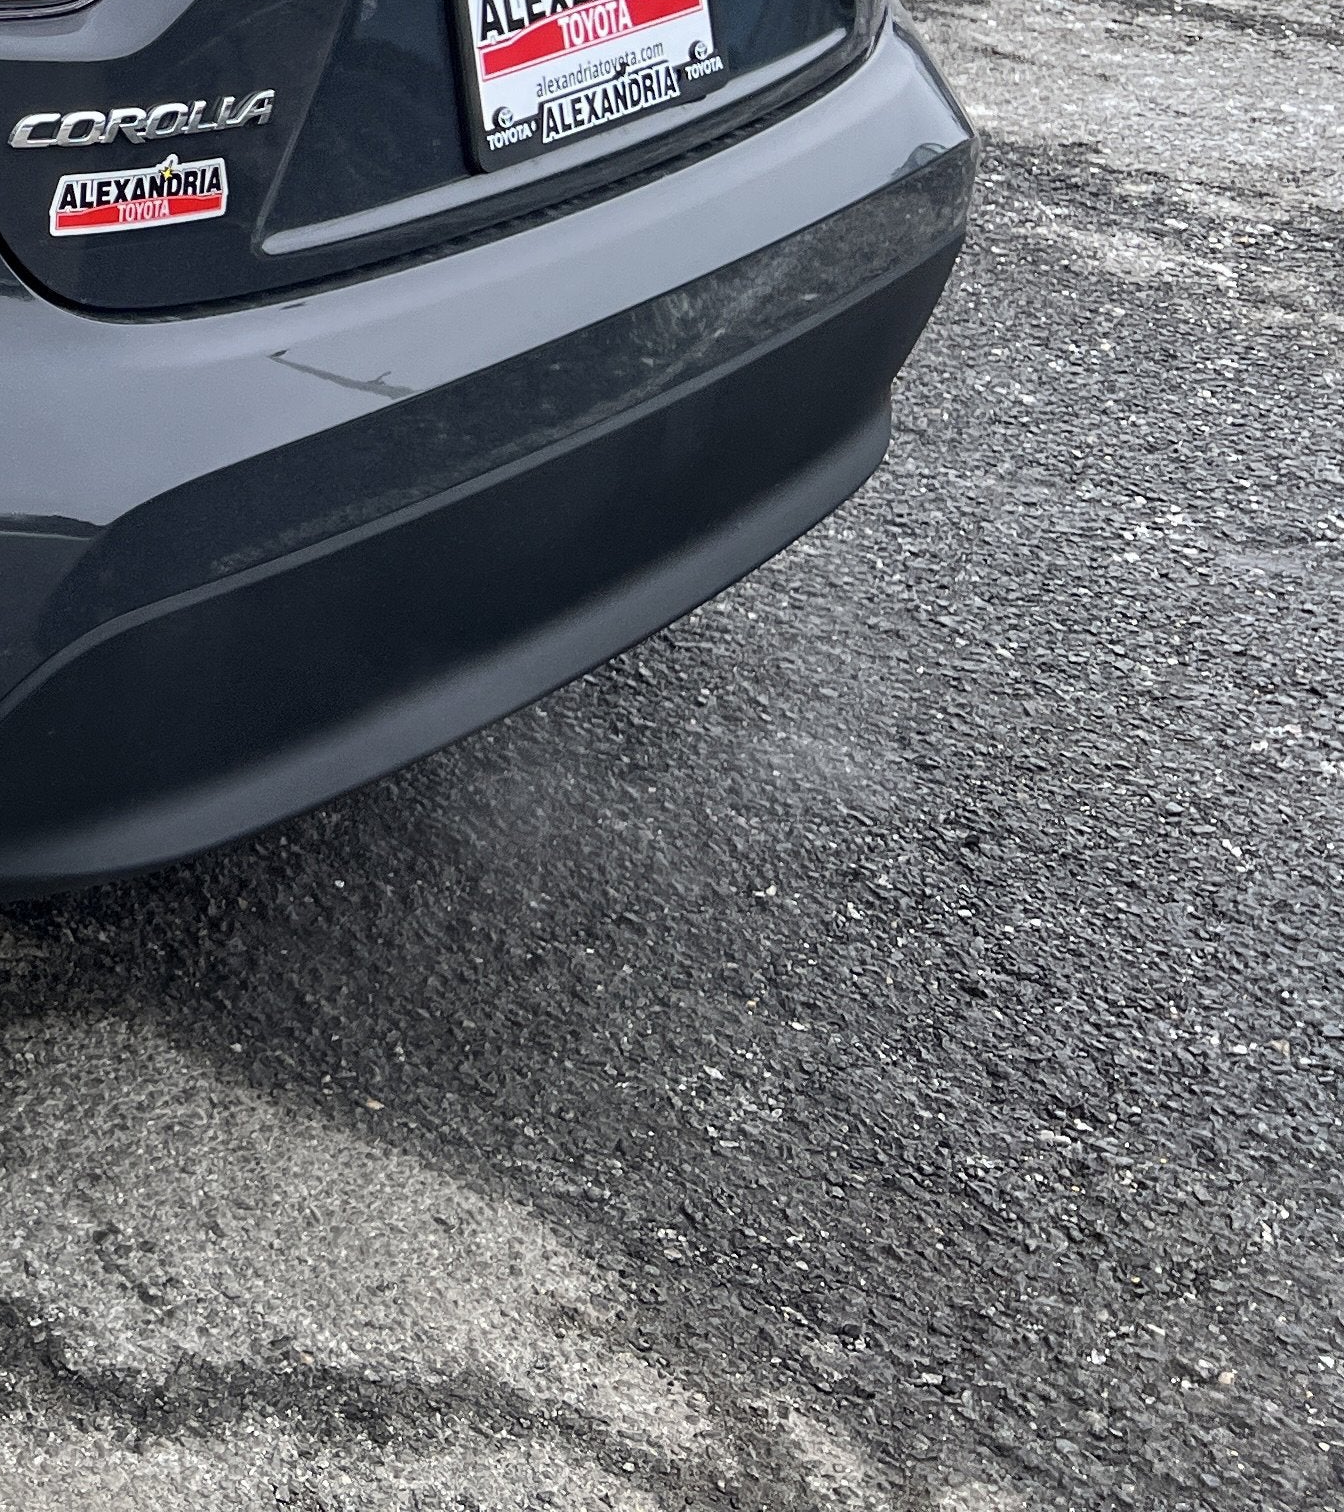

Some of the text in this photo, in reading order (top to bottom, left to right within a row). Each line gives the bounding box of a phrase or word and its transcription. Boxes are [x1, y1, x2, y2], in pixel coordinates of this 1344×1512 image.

[535, 41, 665, 98] alexandriatoyota.com
[7, 88, 275, 148] COROLLA
[486, 55, 724, 150] TOYOTA ALEXANDRIA TOYOTA
[58, 166, 222, 210] ALEXANDRIA
[116, 198, 171, 223] TOYOTA
